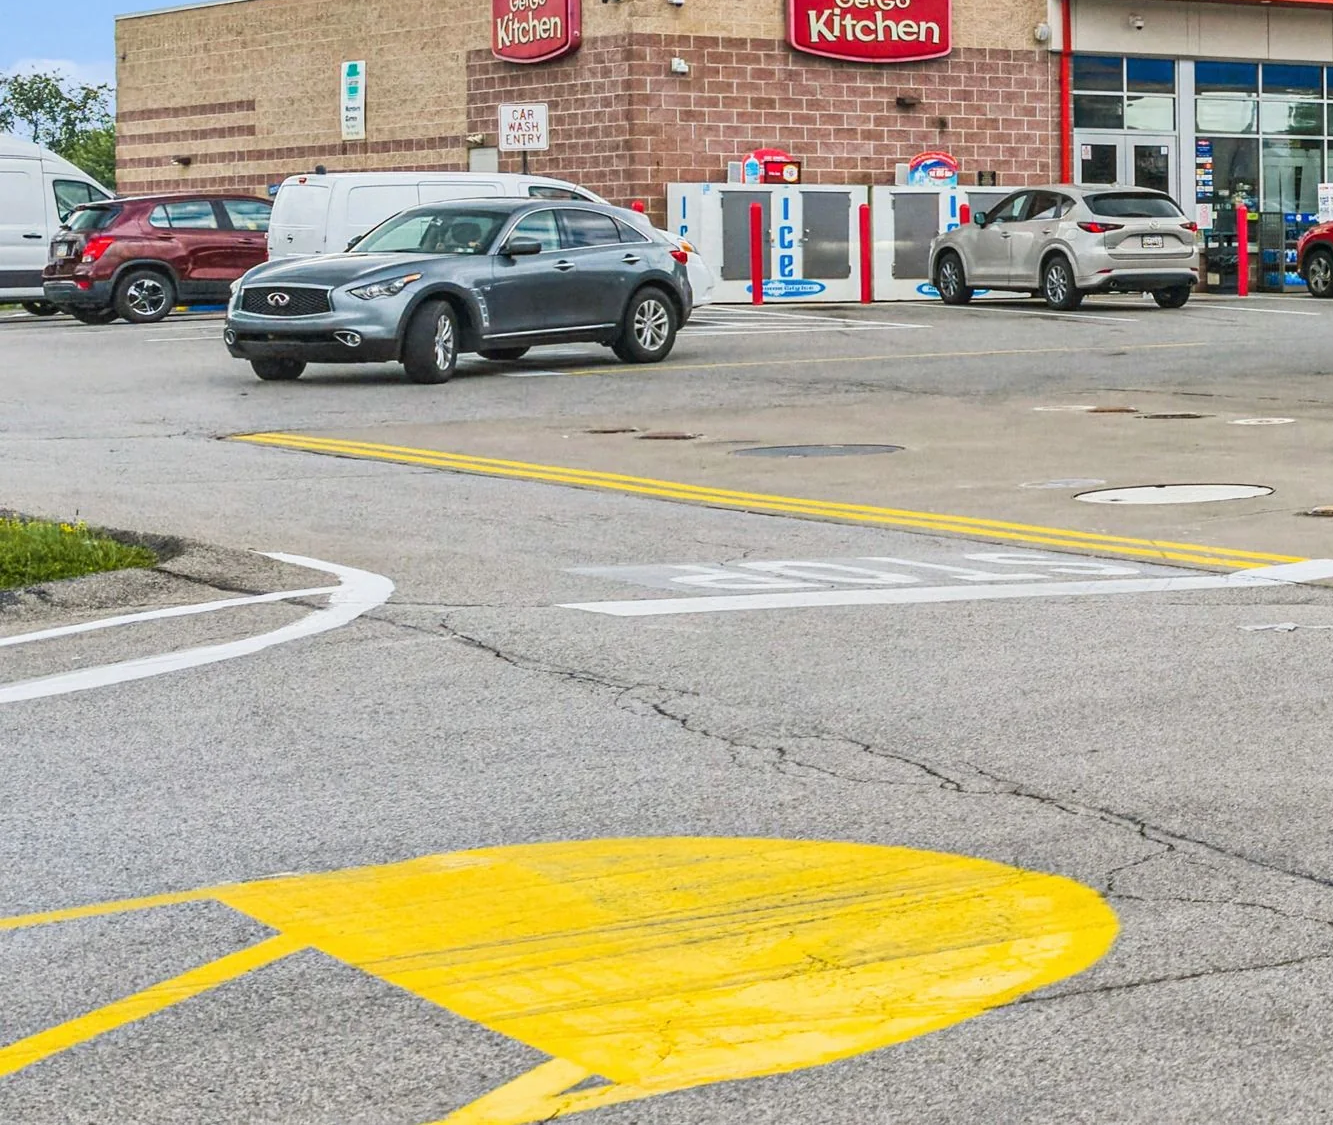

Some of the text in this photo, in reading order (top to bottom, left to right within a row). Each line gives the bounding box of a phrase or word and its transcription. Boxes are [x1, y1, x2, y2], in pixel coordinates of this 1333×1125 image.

[497, 11, 562, 50] Kitchen
[807, 8, 940, 45] Kitchen
[511, 109, 535, 121] CAR
[507, 121, 540, 133] WASH
[505, 133, 542, 146] ENTRY
